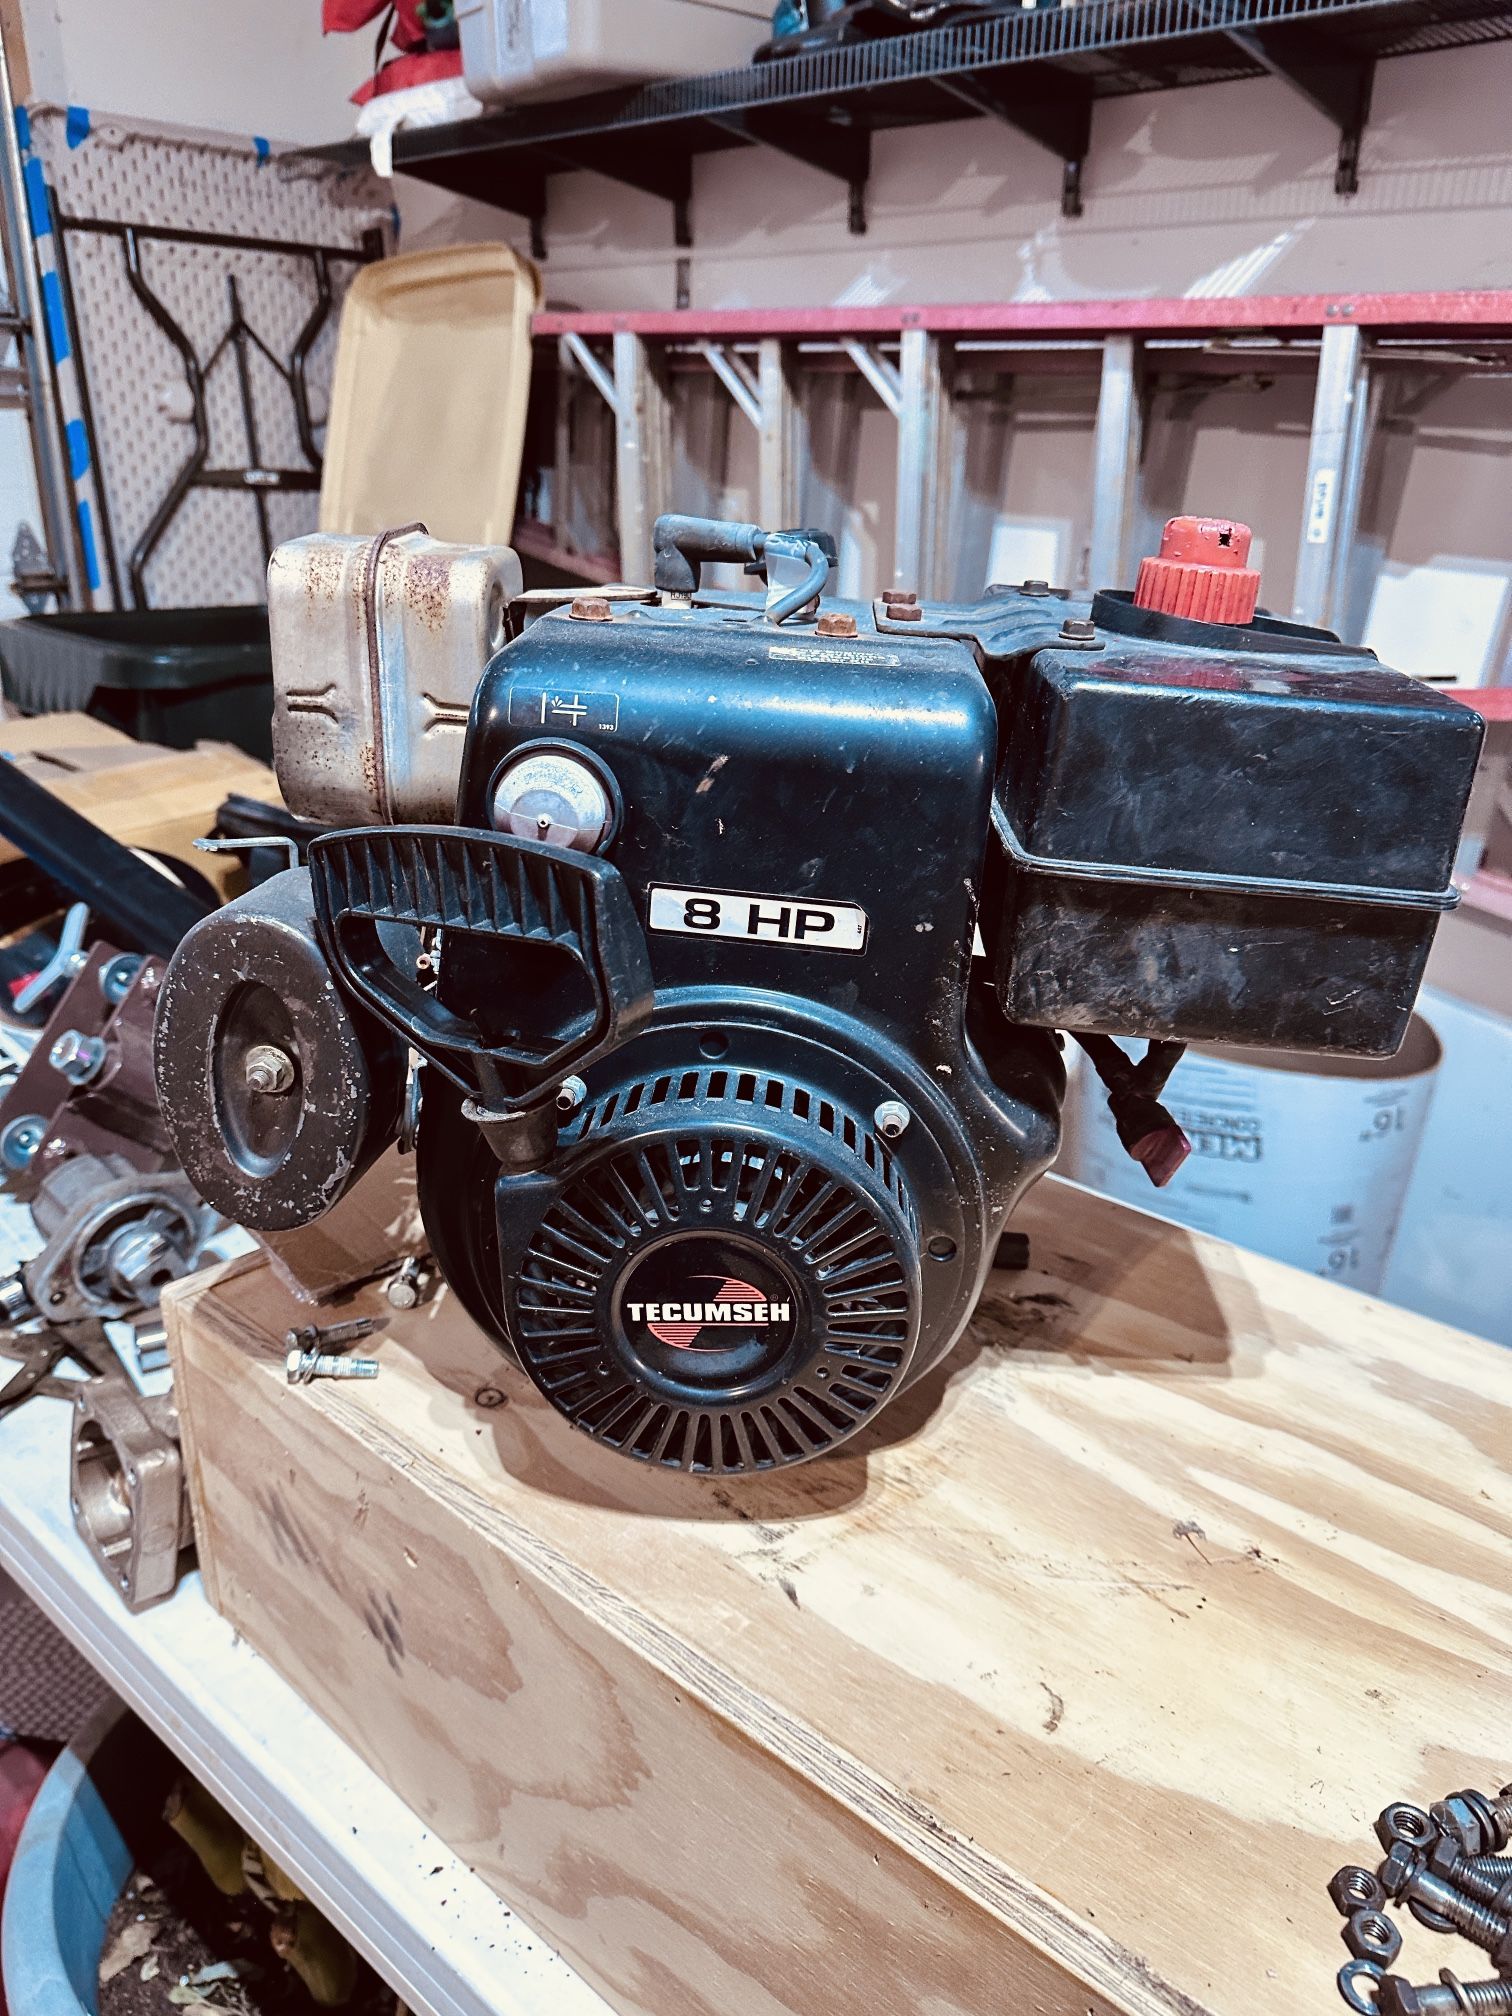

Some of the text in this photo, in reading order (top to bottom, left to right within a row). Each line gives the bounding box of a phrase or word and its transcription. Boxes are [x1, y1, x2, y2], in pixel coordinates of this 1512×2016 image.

[598, 723, 614, 731] 1393
[683, 897, 836, 940] 8 HP
[627, 1303, 790, 1321] TECUMSEH
